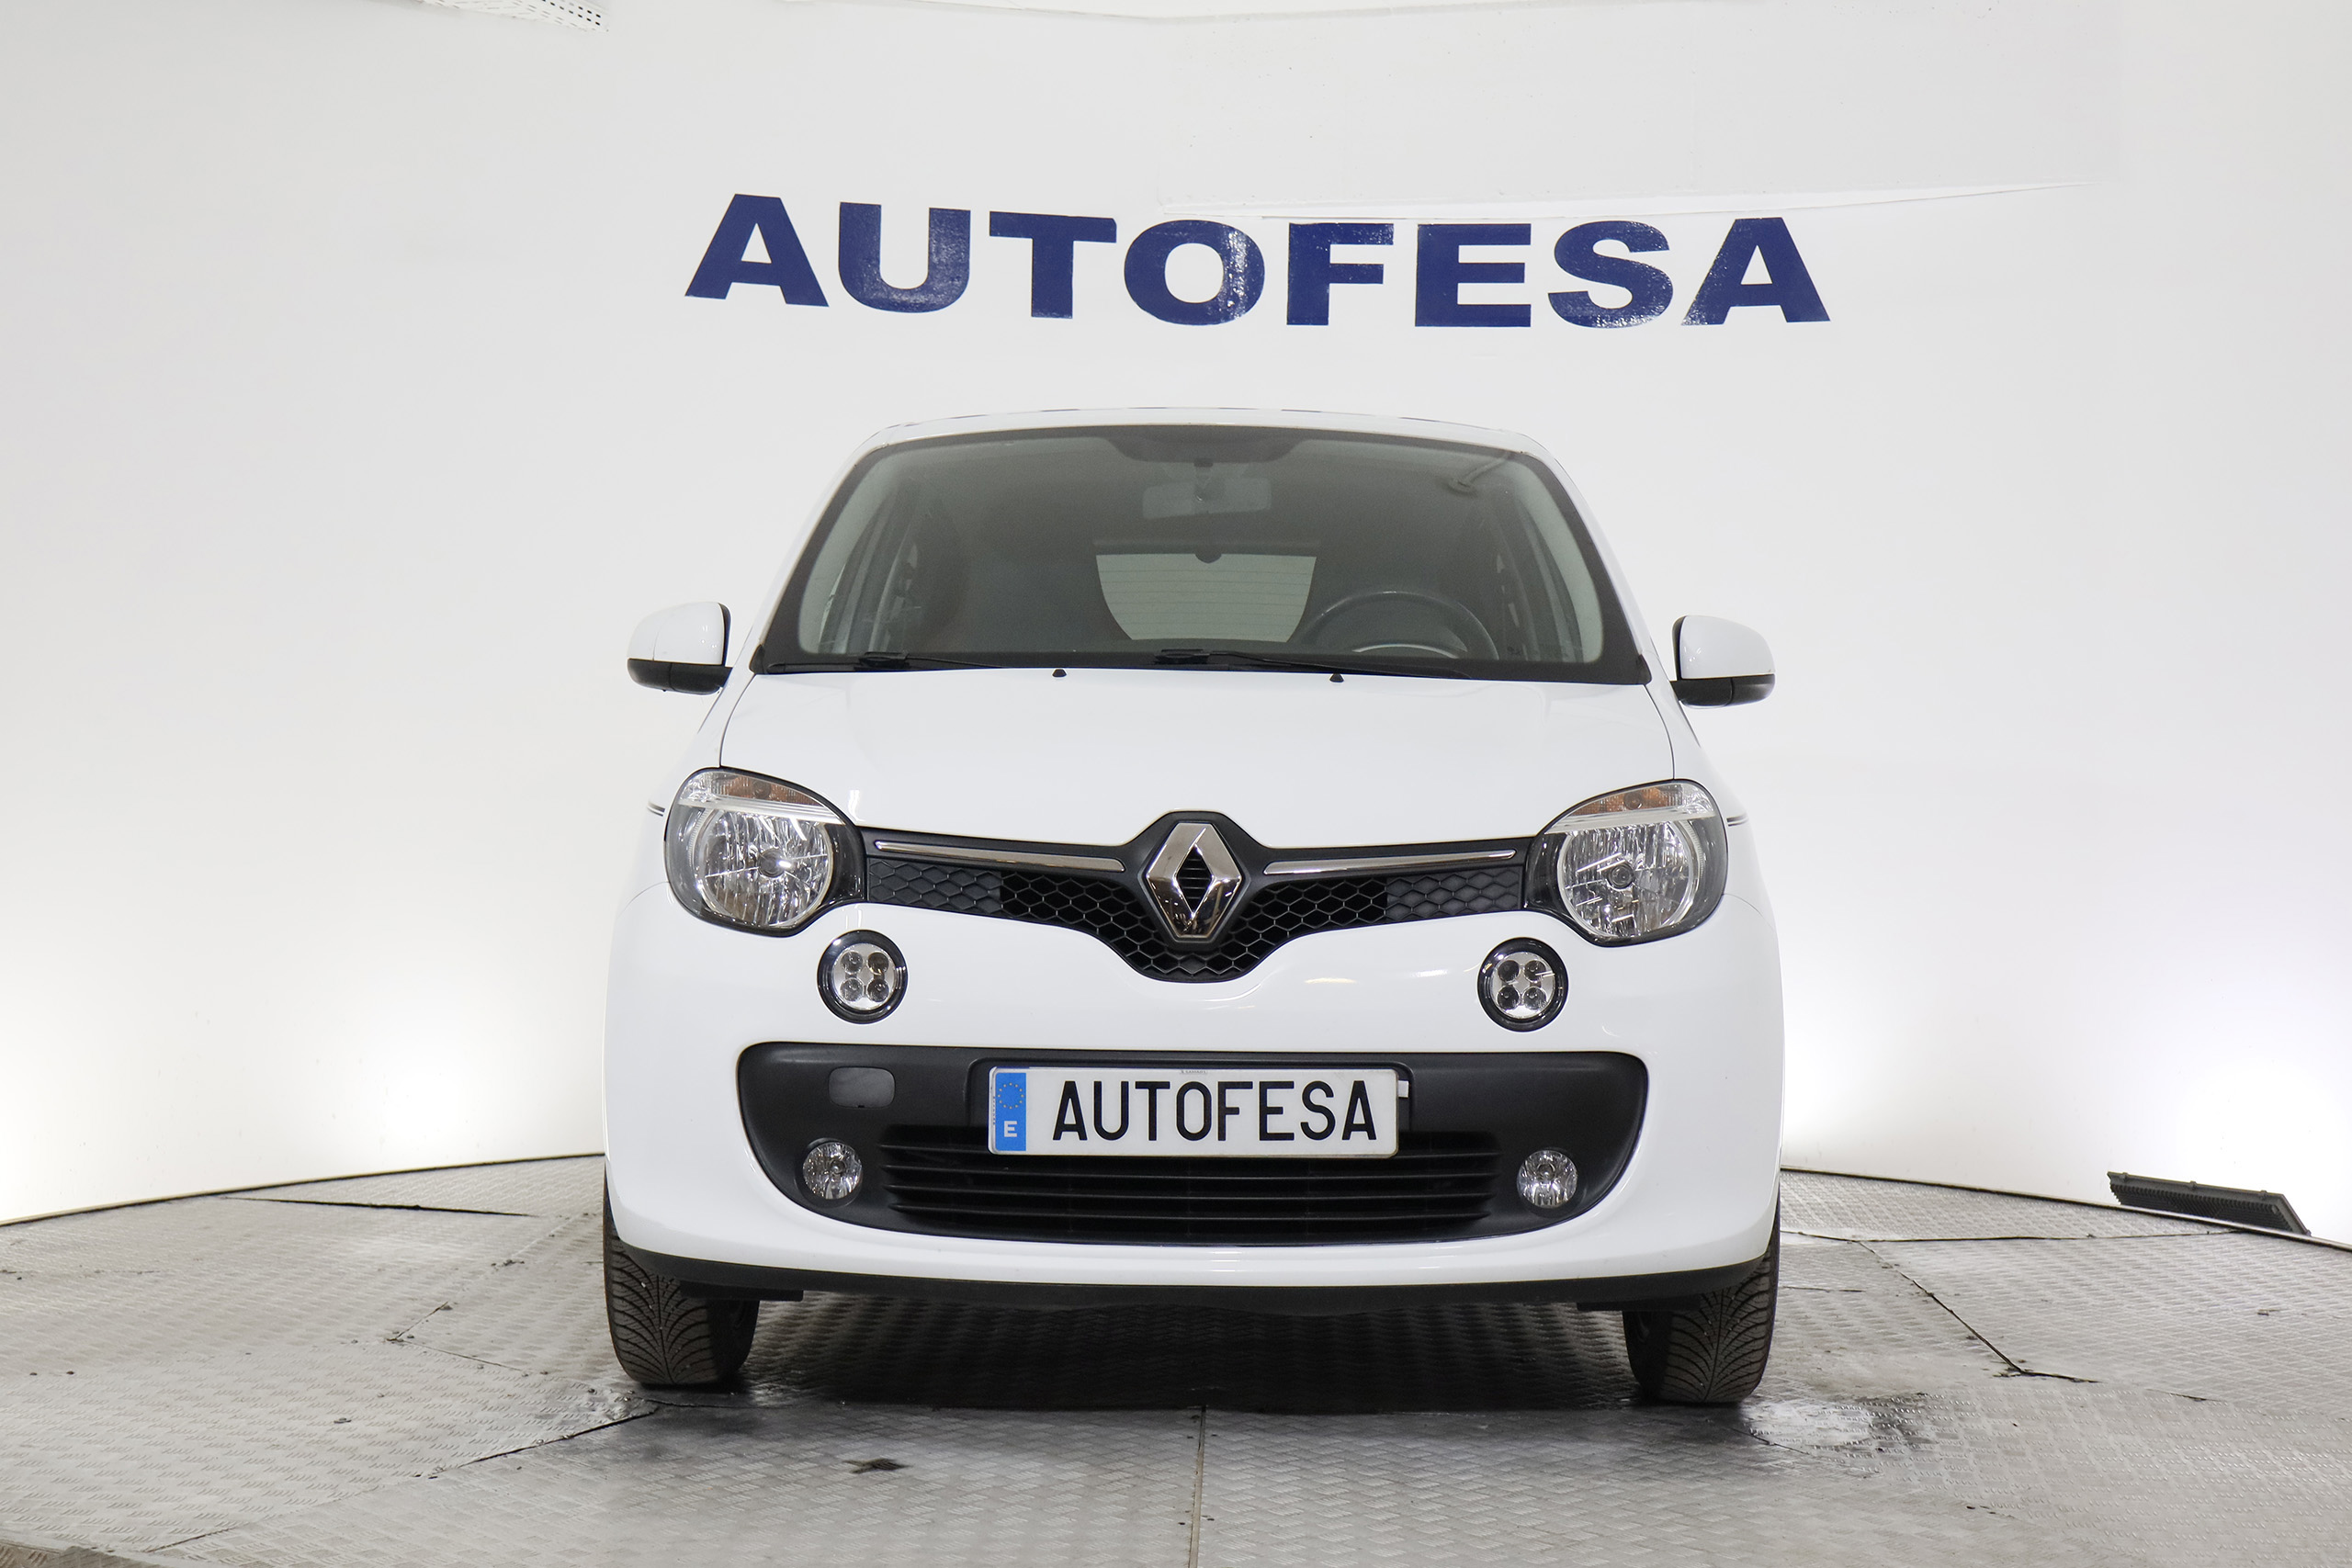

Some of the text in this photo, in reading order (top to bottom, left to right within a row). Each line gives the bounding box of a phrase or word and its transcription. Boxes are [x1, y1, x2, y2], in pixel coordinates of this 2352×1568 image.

[685, 193, 1830, 327] AUTOFESA
[1003, 1120, 1018, 1138] E
[1052, 1080, 1377, 1141] AUTOFESA
